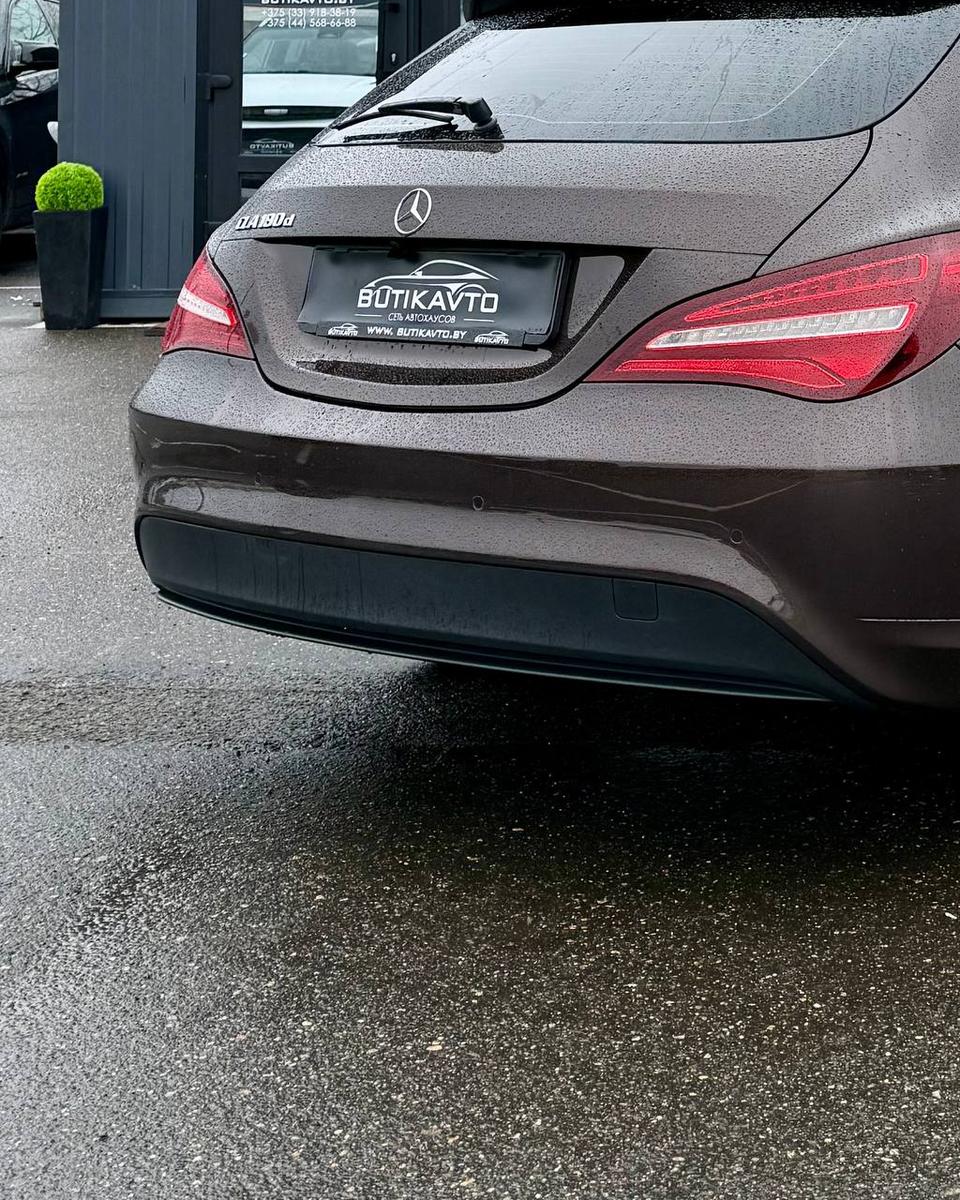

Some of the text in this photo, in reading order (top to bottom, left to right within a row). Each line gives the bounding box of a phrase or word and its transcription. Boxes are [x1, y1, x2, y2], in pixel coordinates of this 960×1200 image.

[262, 8, 356, 19] +375 (33) 918-38-19
[288, 18, 306, 29] (44)
[309, 19, 356, 27] 568-66-88
[357, 288, 499, 313] BUTIKAVTO
[388, 313, 456, 323] СЕТЬ АВТОХАУСОВ
[367, 326, 467, 339] WWW. BUTIKAVTO.BY
